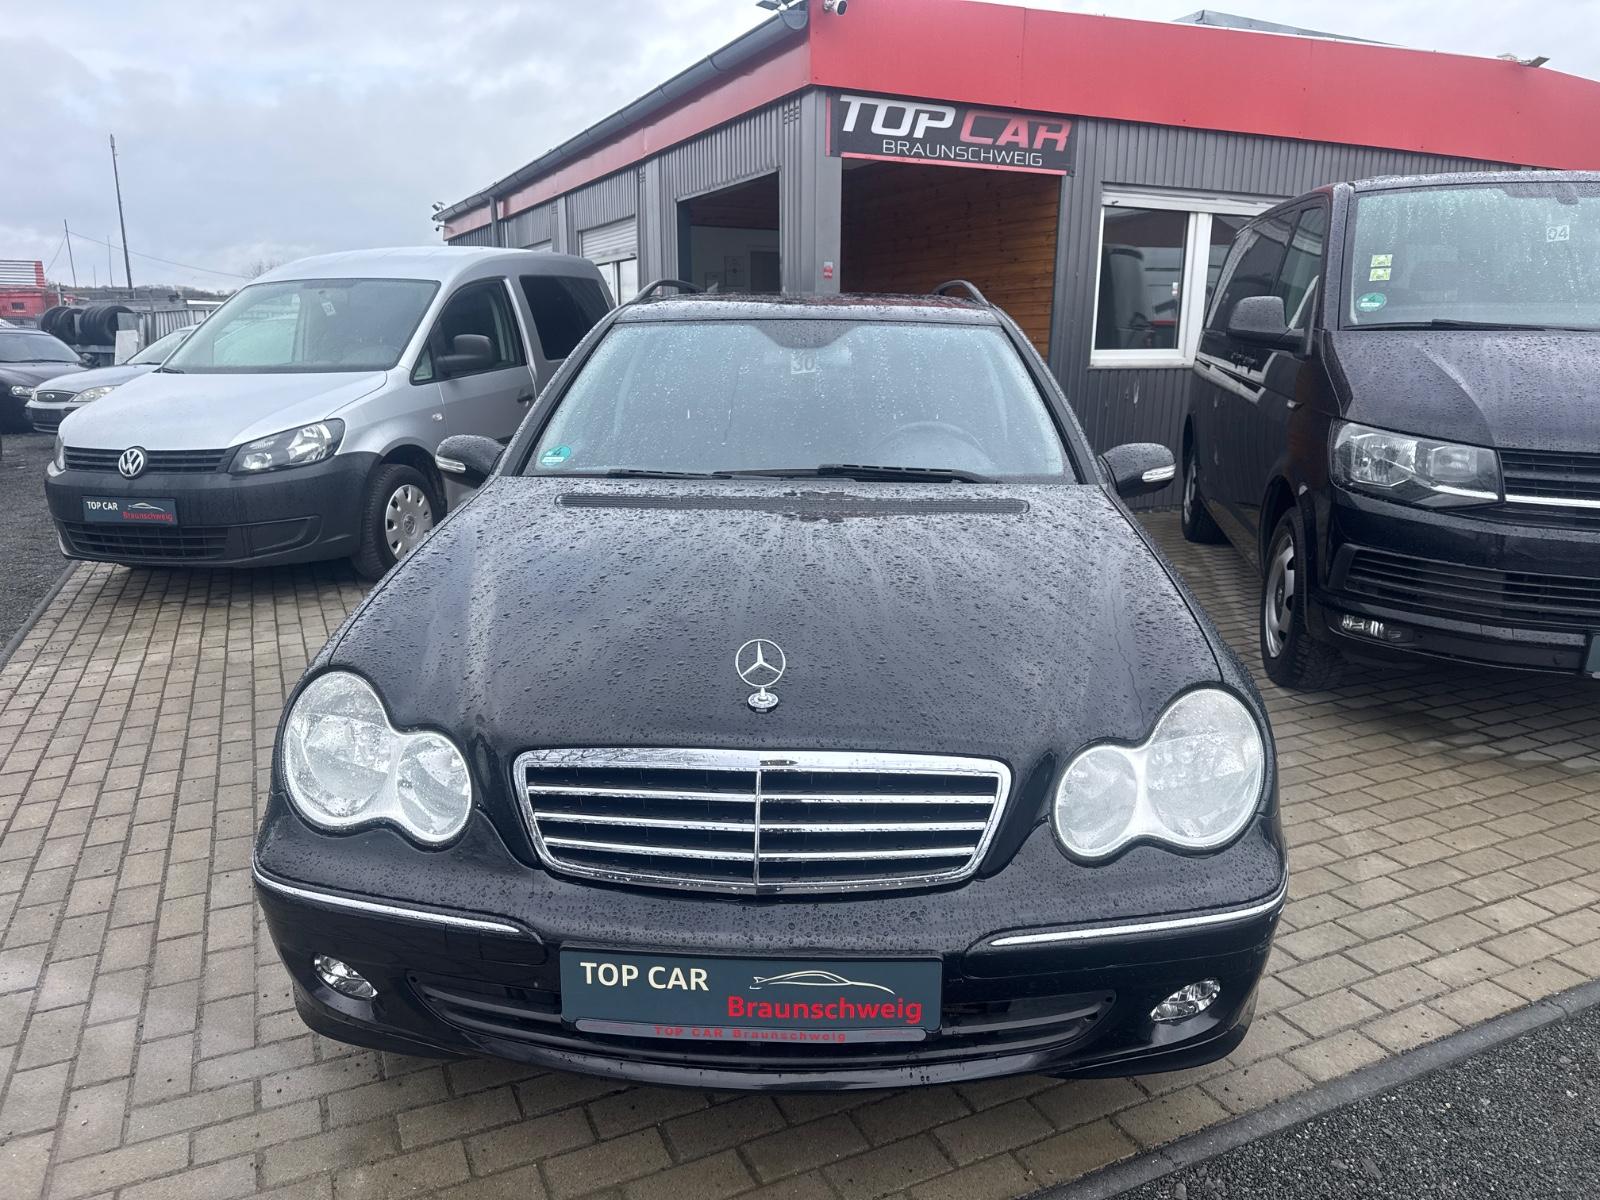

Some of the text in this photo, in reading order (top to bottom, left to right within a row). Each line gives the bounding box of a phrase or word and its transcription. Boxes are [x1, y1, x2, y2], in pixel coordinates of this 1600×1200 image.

[840, 94, 1073, 152] TOP CAR
[882, 139, 1043, 167] BRAUNSCHWEIG
[86, 501, 118, 511] TOP CAR
[580, 962, 709, 991] TOP CAR
[727, 996, 922, 1024] Braunschweig
[655, 1026, 846, 1043] TOP CAR Braunschweig
